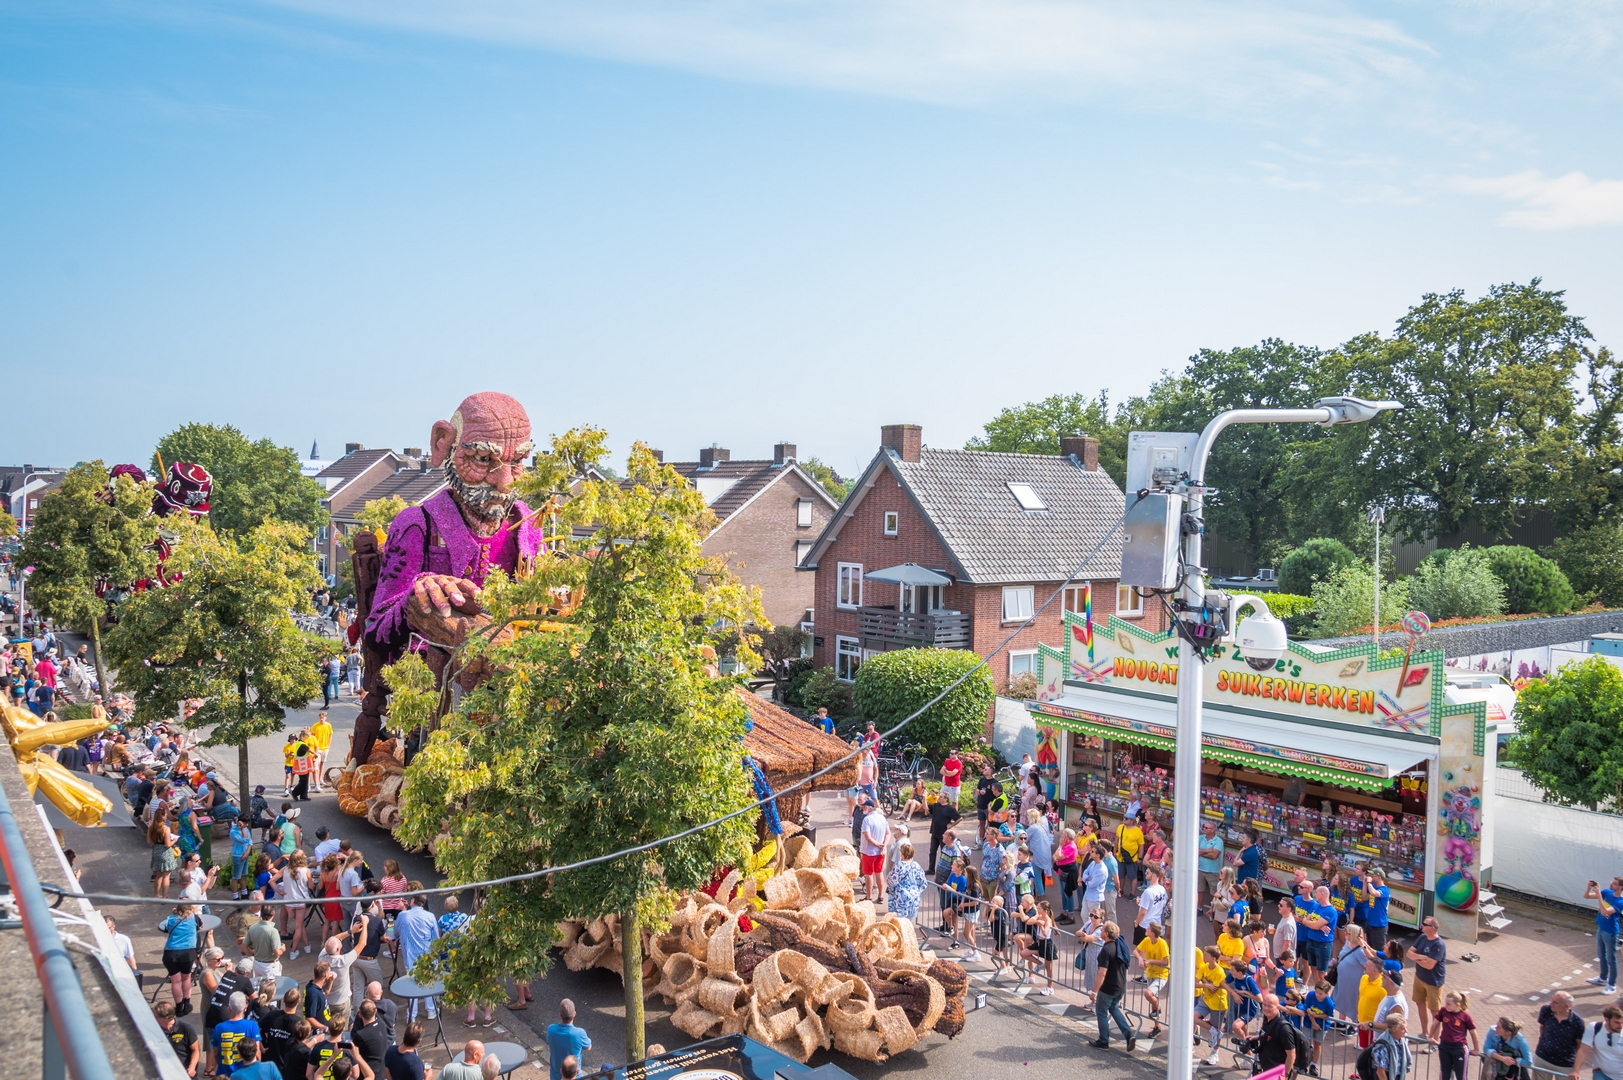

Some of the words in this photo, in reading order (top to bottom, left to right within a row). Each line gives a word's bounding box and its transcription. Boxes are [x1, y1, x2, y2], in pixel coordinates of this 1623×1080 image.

[1113, 656, 1178, 685] NOUGAT
[1217, 669, 1375, 714] SUIKERWERKEN
[662, 1053, 694, 1065] samen
[679, 1051, 719, 1067] verschil
[693, 1049, 707, 1057] en
[621, 1060, 662, 1077] genieten
[646, 1062, 681, 1076] tussen
